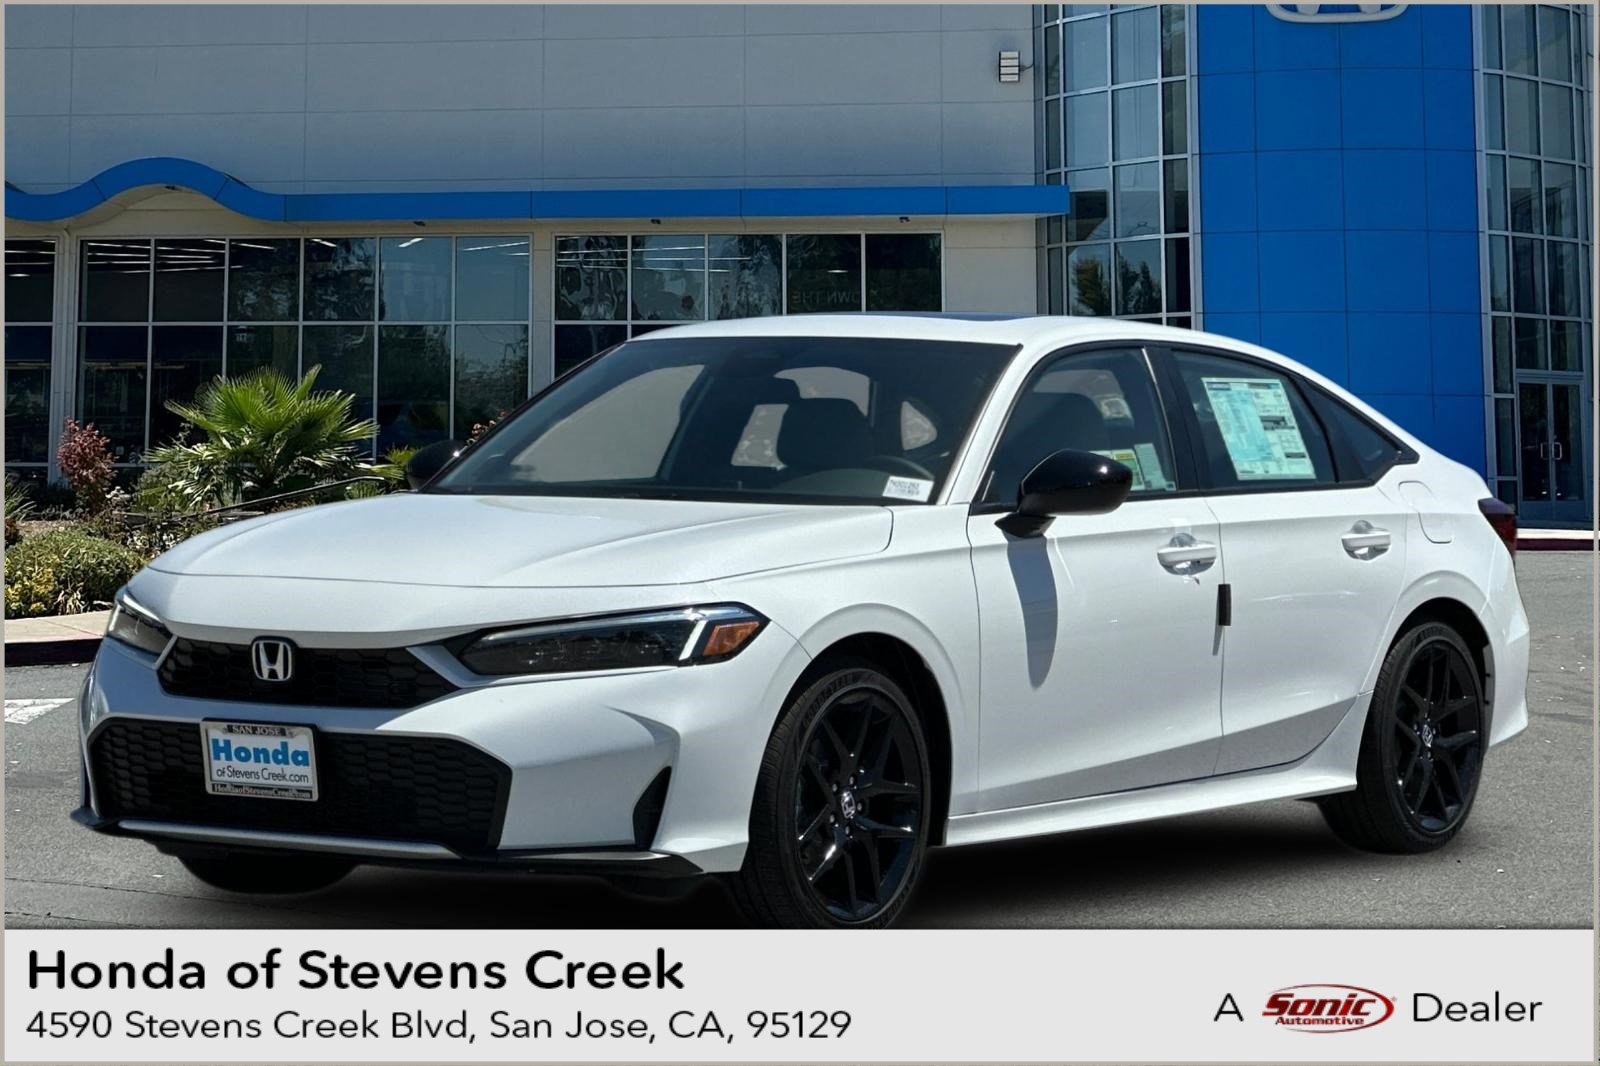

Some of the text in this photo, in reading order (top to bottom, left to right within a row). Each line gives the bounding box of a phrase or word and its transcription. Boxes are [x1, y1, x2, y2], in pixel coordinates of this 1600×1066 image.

[231, 725, 282, 736] SAN JOSE
[211, 738, 310, 767] Honda
[216, 765, 309, 784] of Stevens Creek.com
